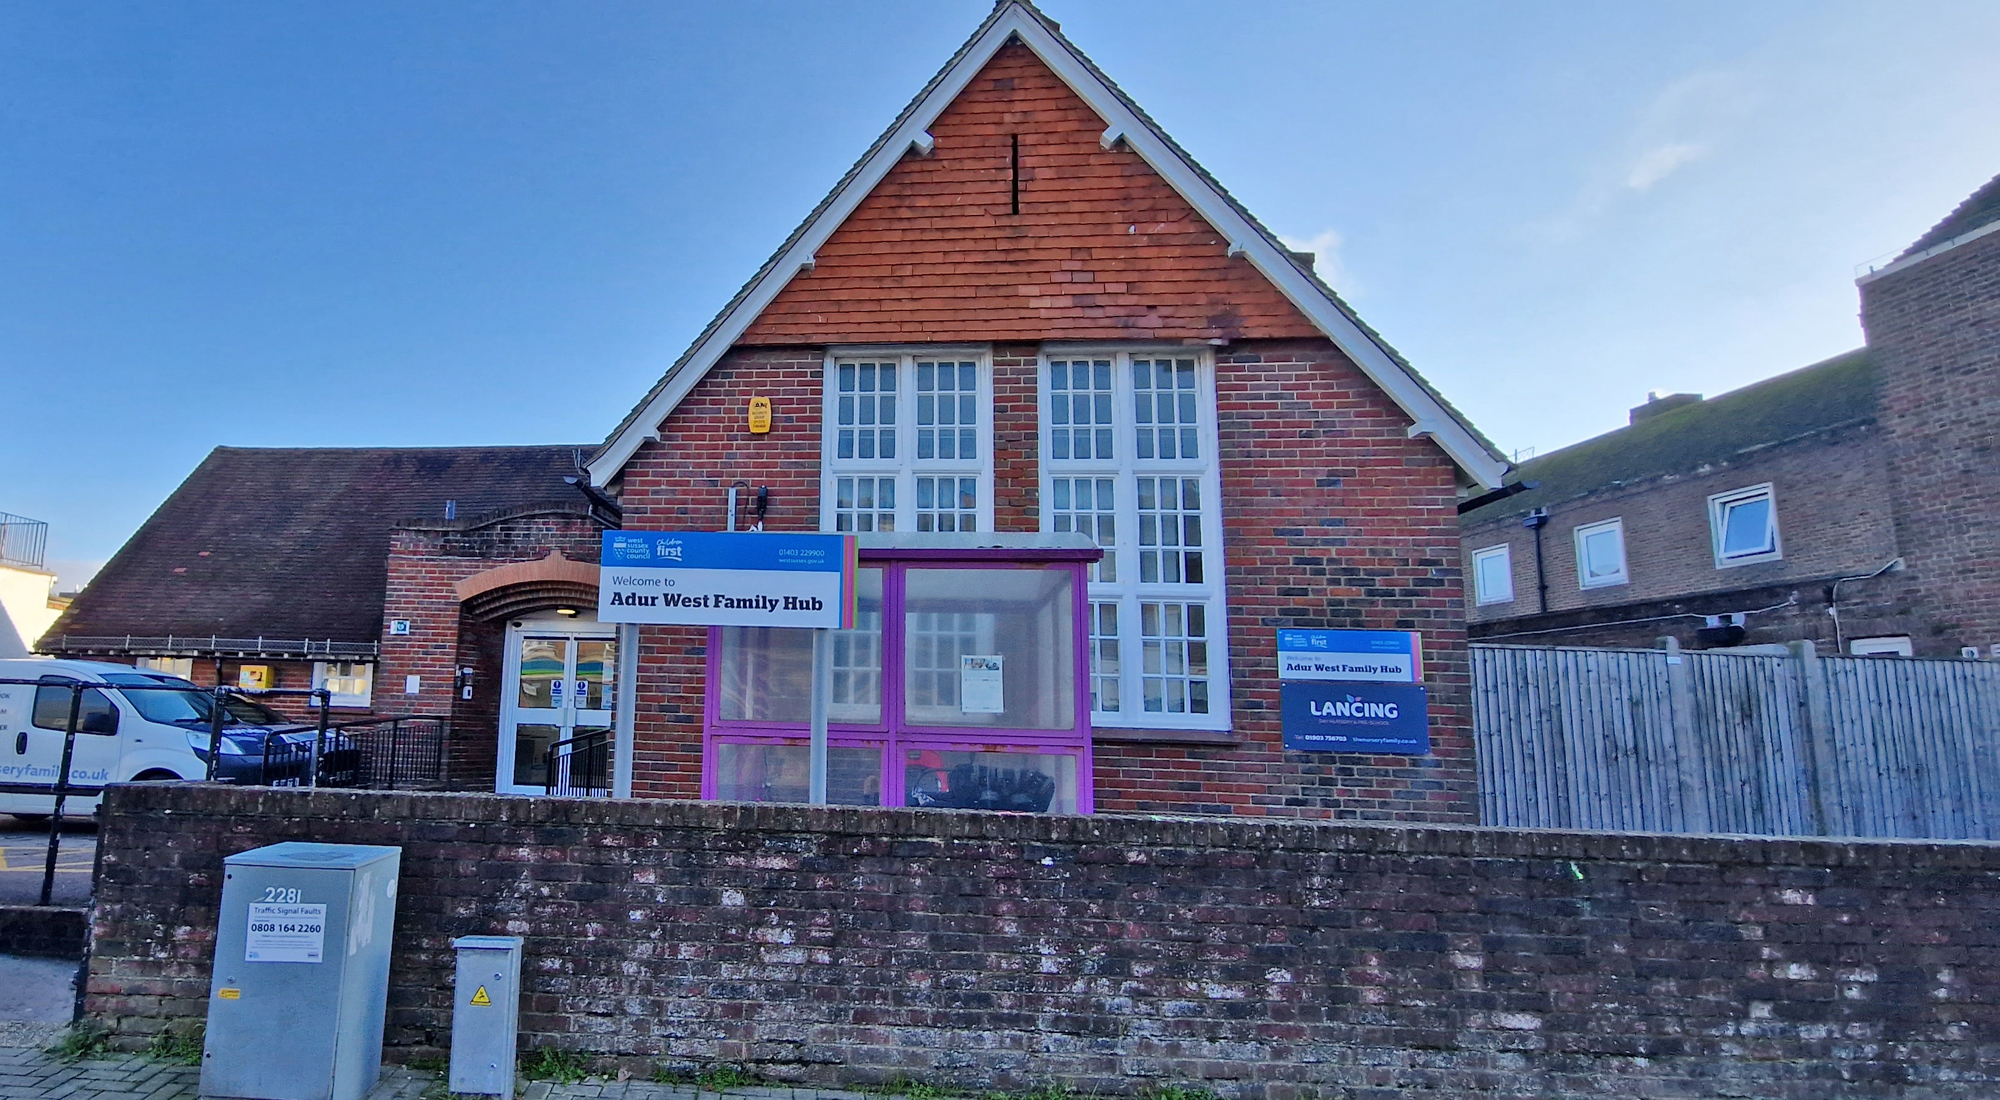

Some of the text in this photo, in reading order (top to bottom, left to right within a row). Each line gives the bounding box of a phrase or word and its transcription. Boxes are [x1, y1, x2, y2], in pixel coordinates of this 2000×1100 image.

[657, 545, 682, 557] first
[612, 576, 676, 587] Welcome to
[610, 592, 823, 613] Adur West Family Hub
[1286, 663, 1402, 674] Adur West Family Hub
[1310, 701, 1398, 719] LANCING
[277, 907, 299, 915] Signal
[251, 923, 322, 934] 0808 164 2260
